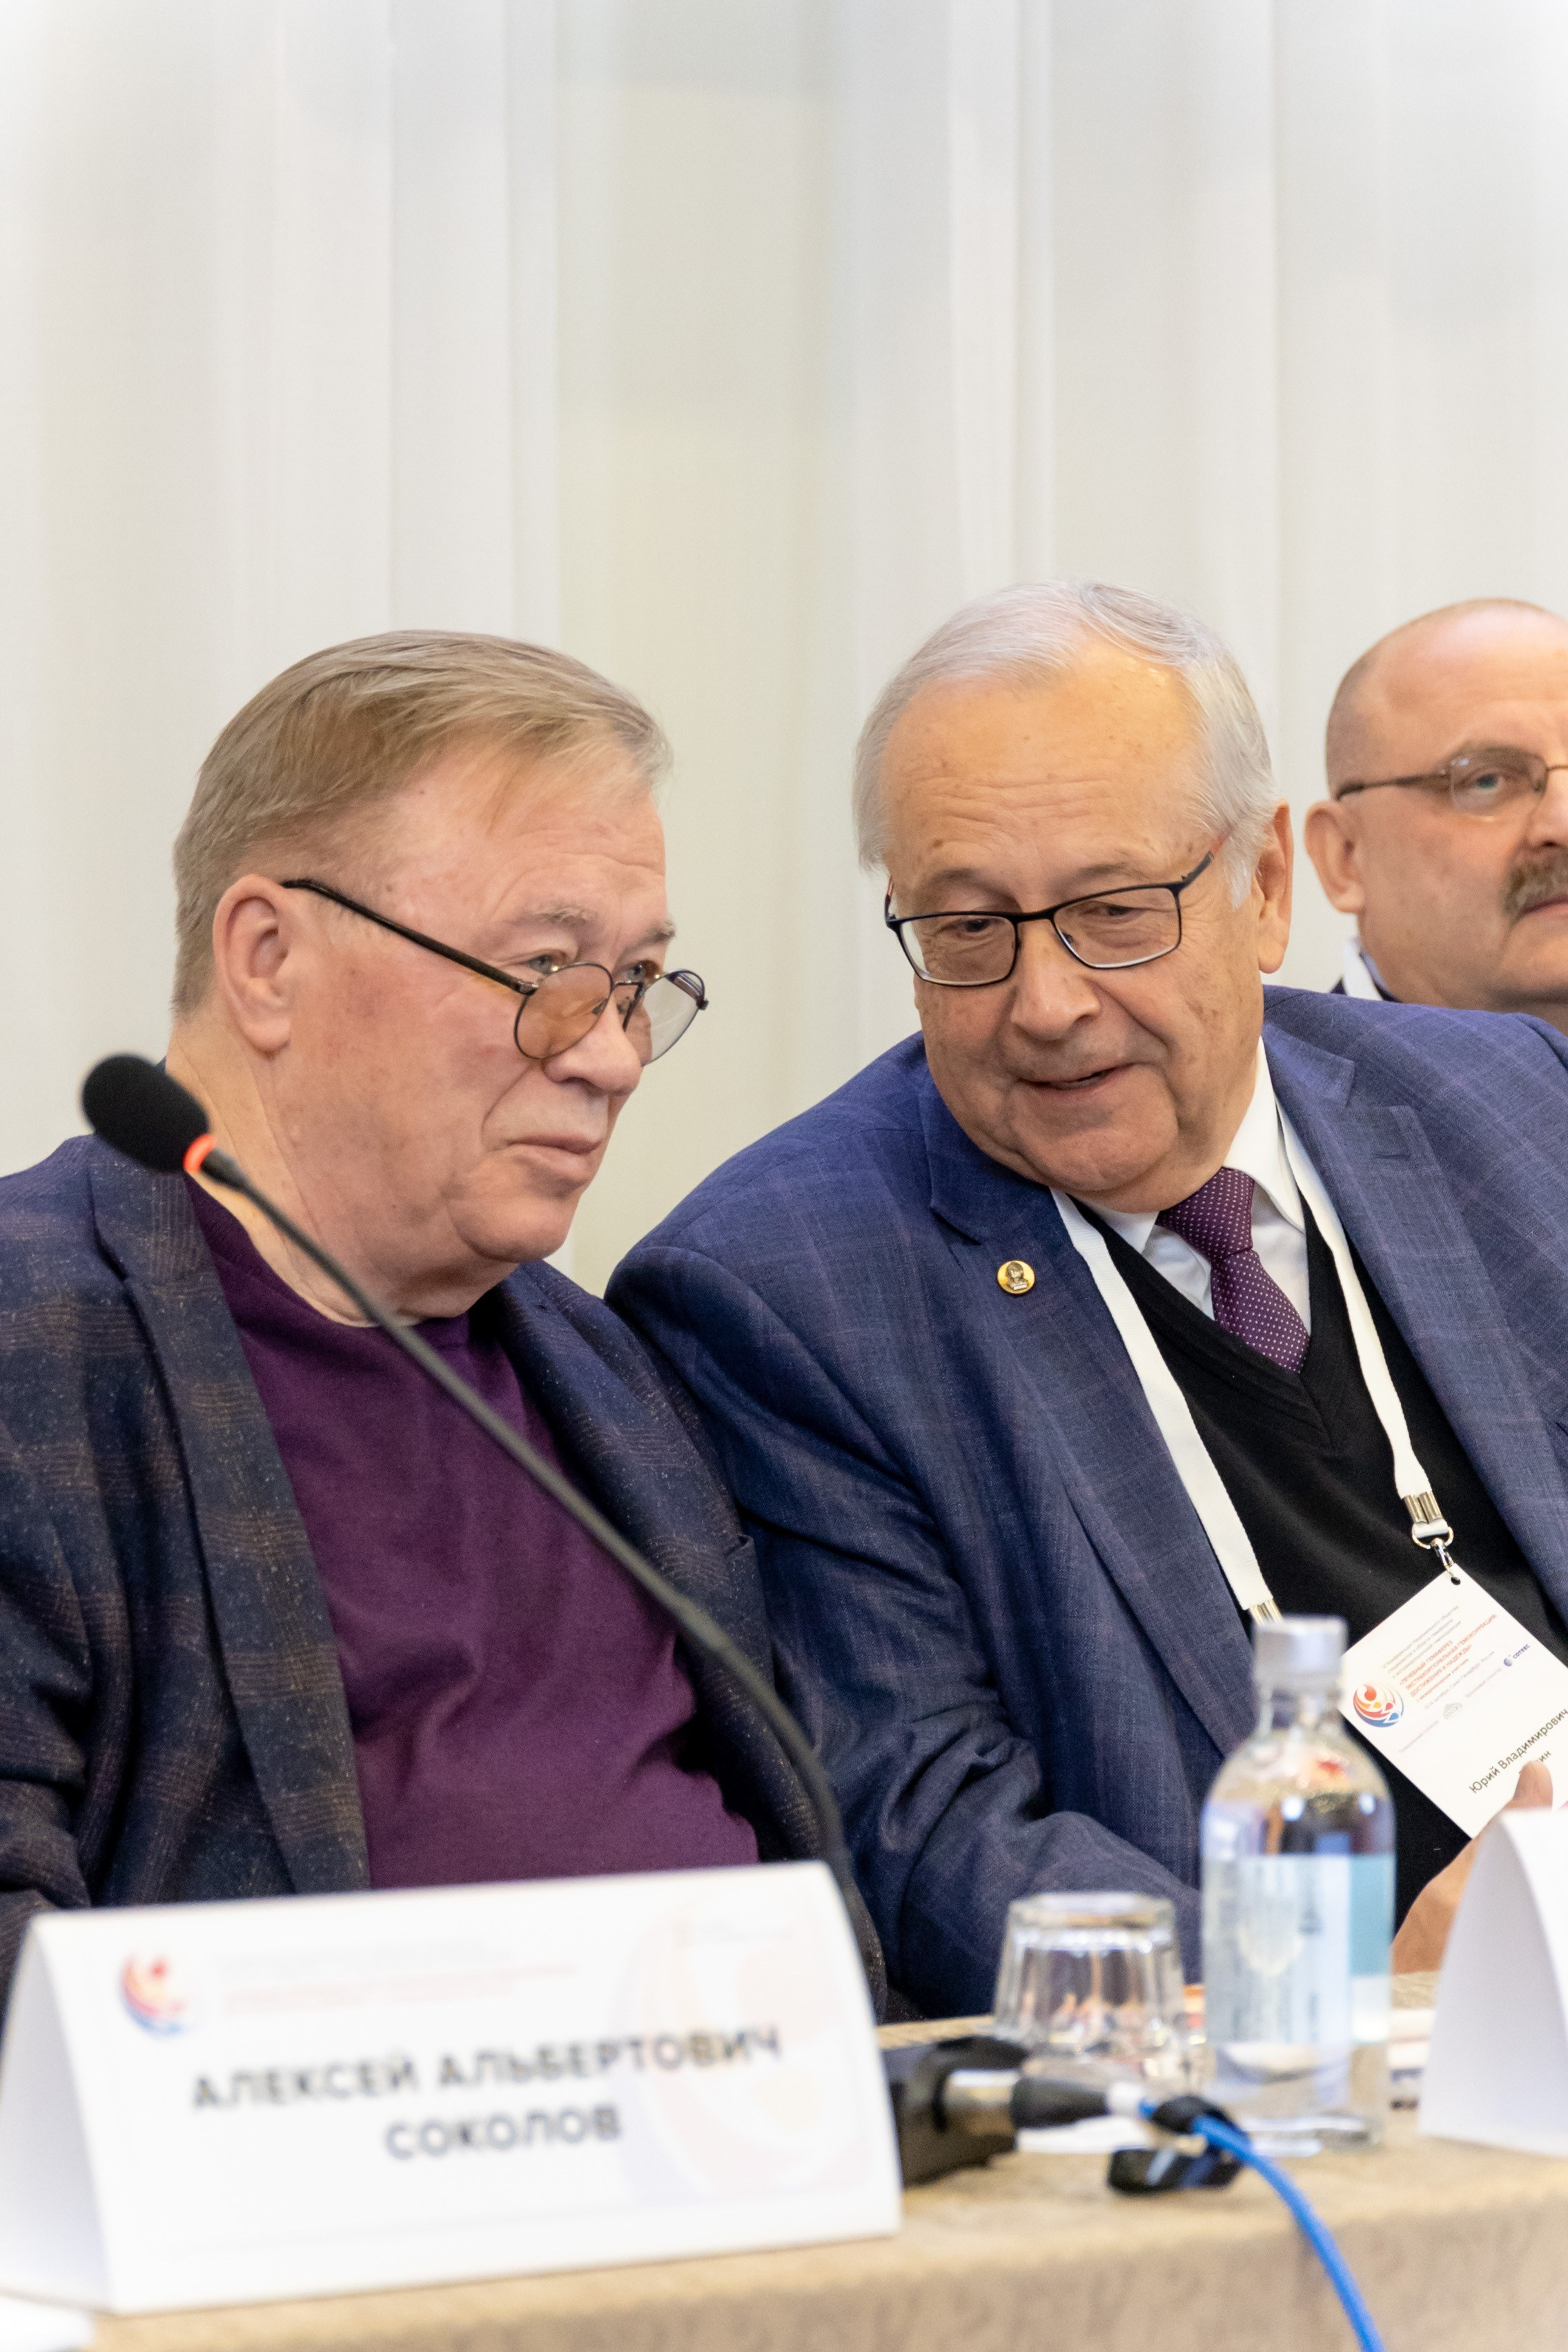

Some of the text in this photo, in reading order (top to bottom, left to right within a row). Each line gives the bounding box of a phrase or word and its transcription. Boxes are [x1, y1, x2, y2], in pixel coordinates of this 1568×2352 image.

[1468, 1765, 1500, 1794] Юрий
[1497, 1708, 1567, 1770] Владимирович
[193, 2024, 782, 2108] АЛЕКСЕЙ АЛЬБЕРТОВИЧ
[384, 2103, 622, 2160] СОКОЛОВ
